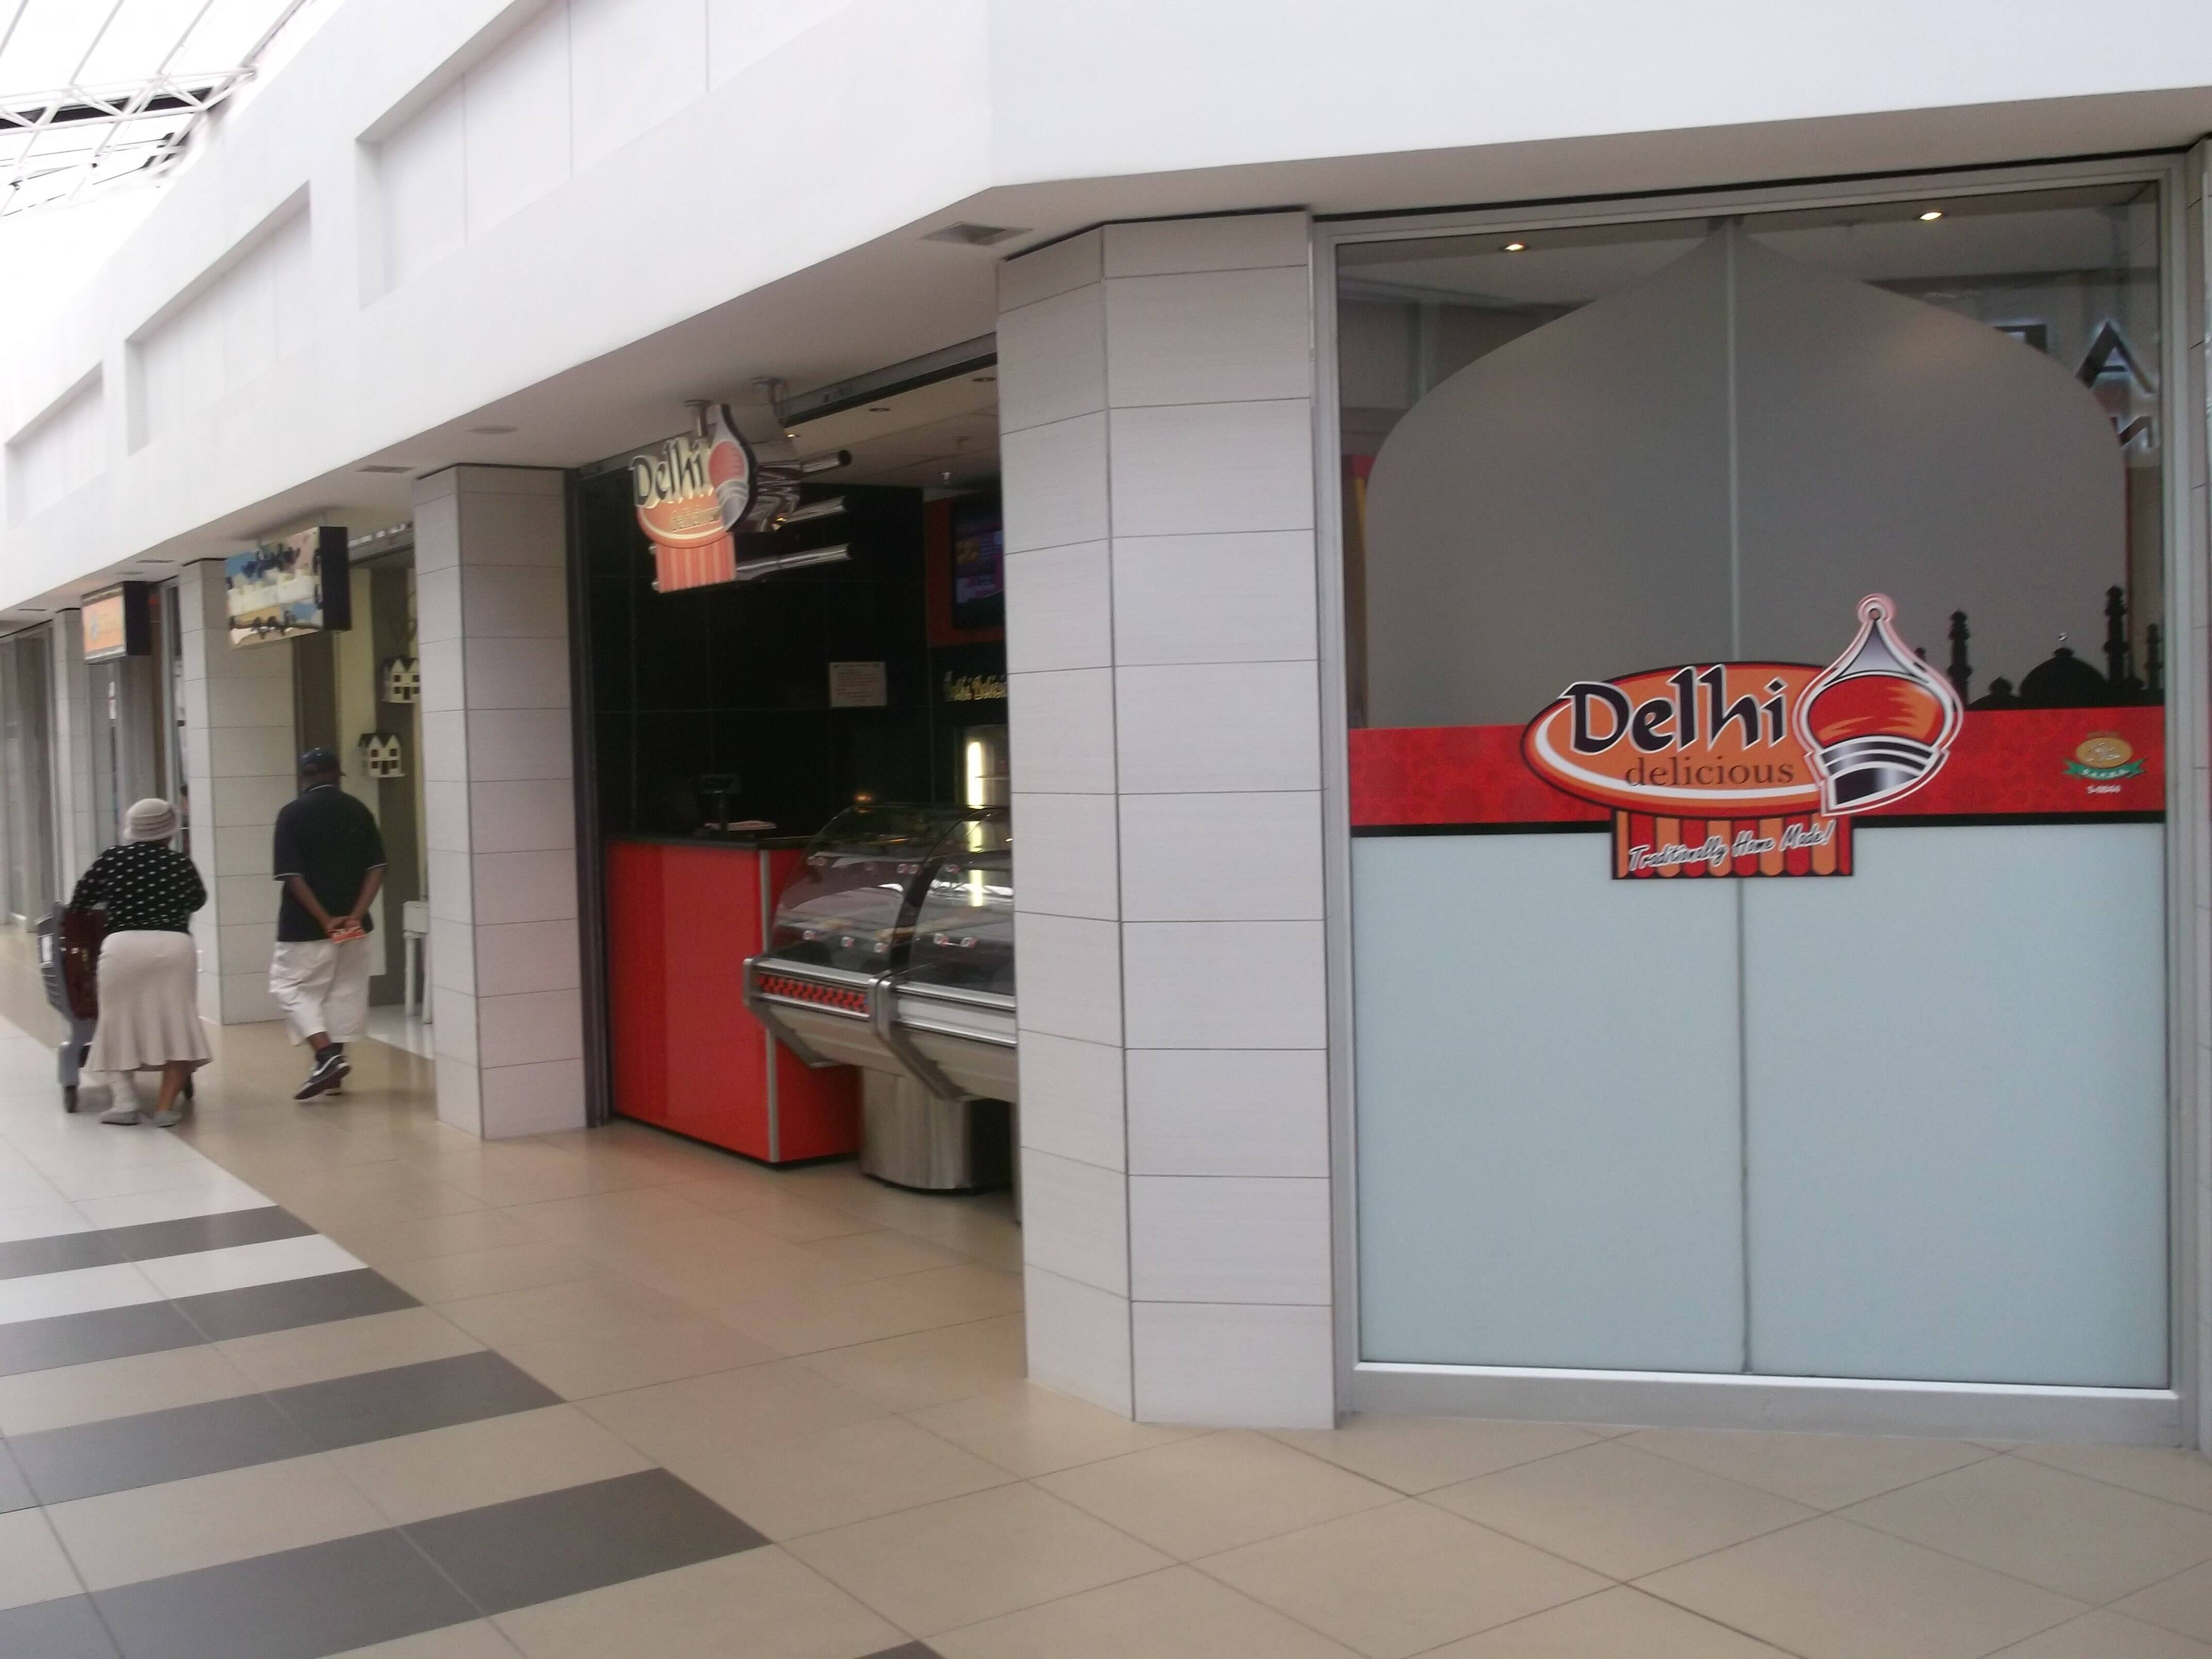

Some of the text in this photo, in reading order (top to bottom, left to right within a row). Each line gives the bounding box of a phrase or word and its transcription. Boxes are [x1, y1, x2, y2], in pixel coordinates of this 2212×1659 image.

[629, 437, 710, 508] Delhi
[1558, 664, 1787, 755] Delhi
[1625, 755, 1794, 786] delicious
[1629, 835, 1728, 871] Traditionally
[1732, 830, 1776, 857] Home
